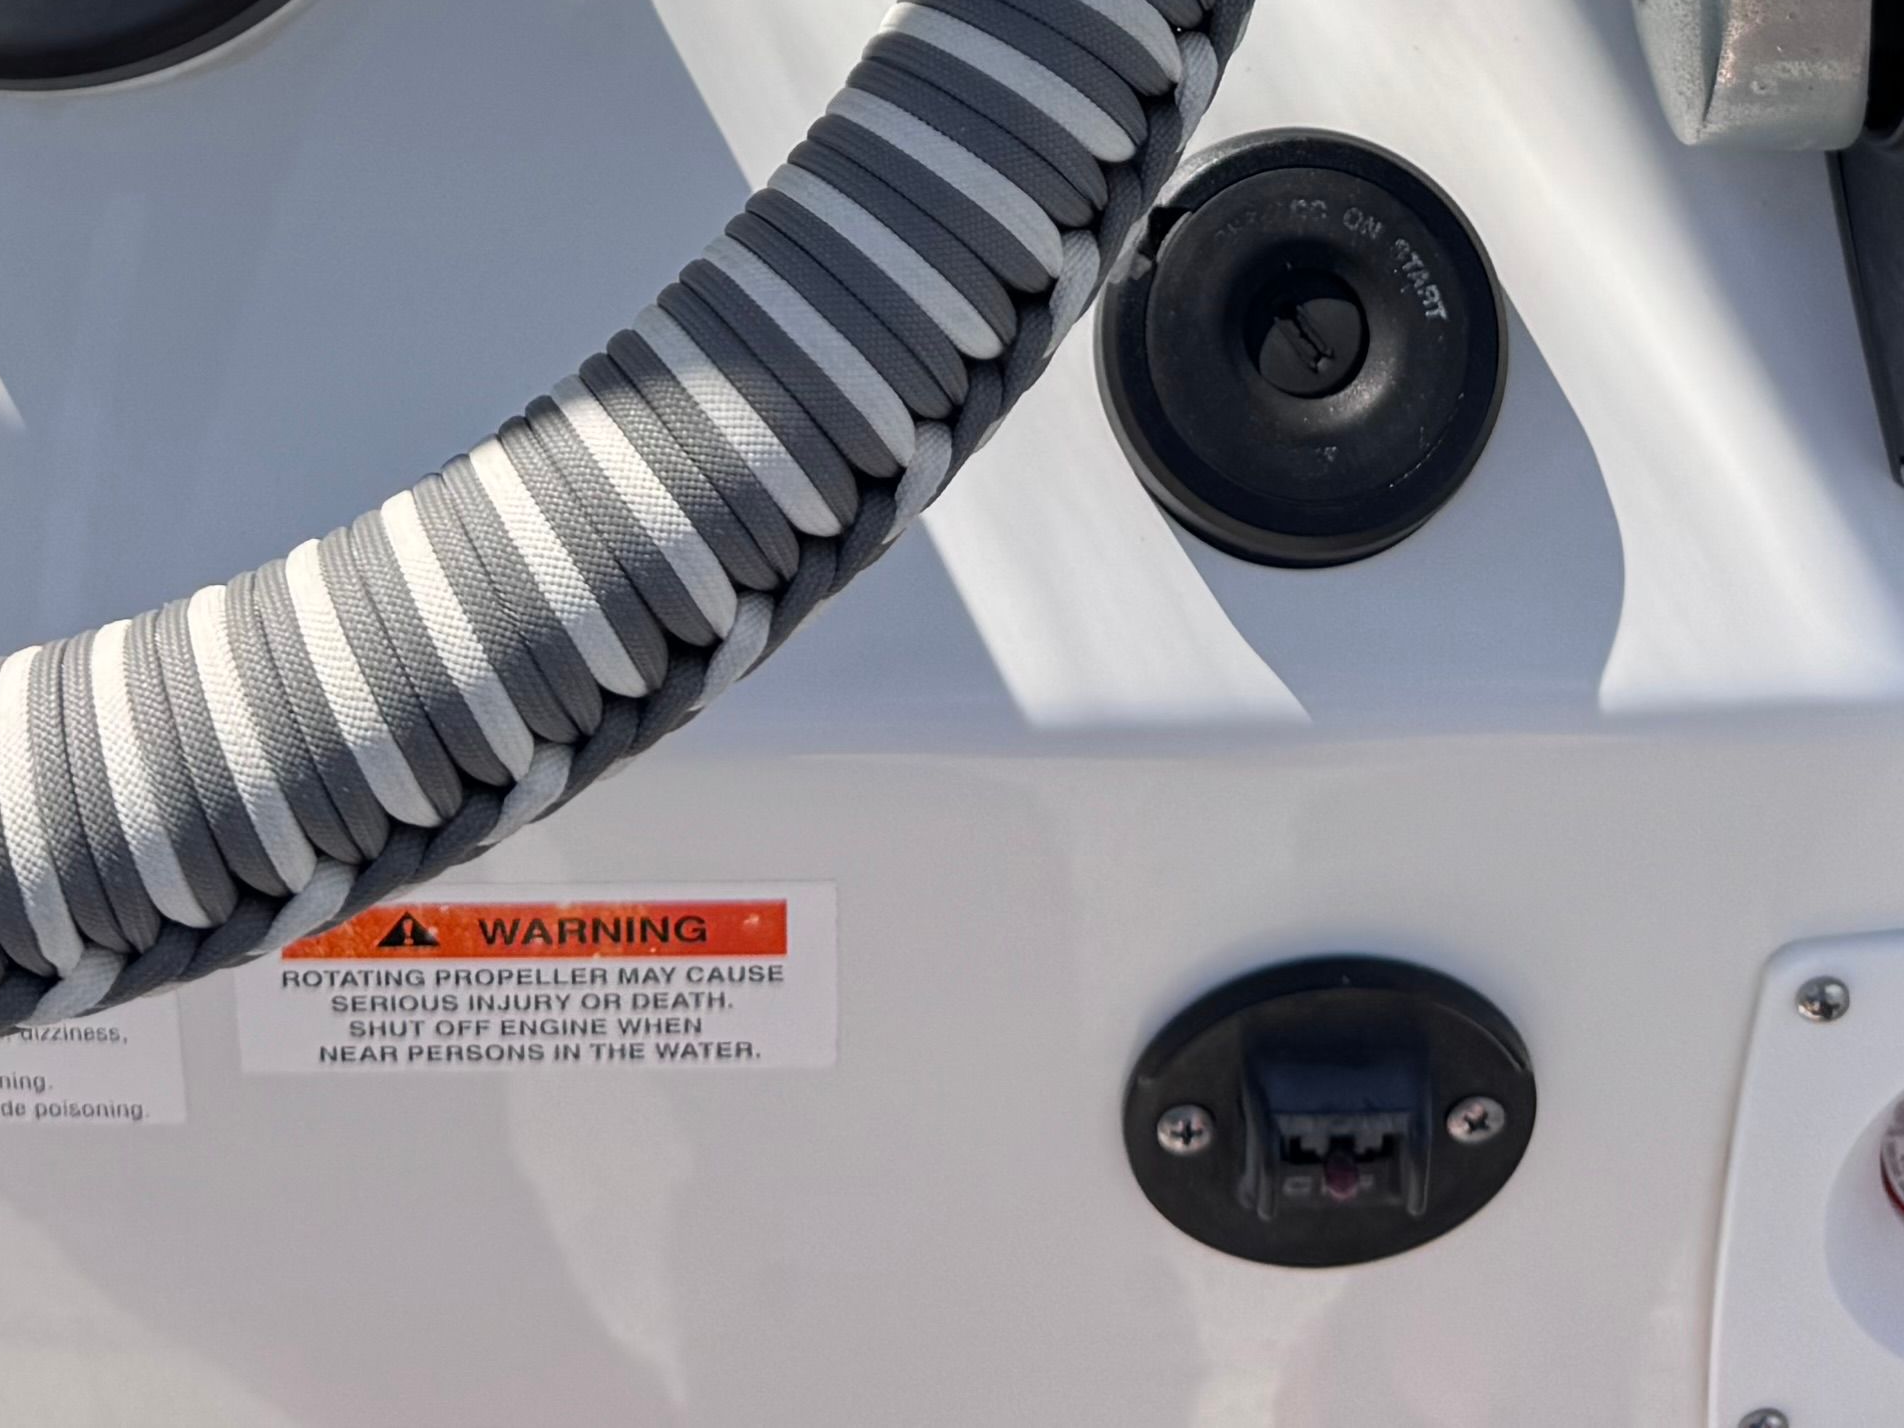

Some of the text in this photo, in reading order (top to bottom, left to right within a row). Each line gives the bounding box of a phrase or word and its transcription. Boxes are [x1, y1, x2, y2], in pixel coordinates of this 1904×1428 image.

[477, 914, 708, 946] WARNING
[281, 964, 786, 988] ROTATING PROPELLER MAY CAUSE
[331, 990, 735, 1013] SERIOUS INJURY OR DEATH.
[349, 1016, 704, 1039] SHUT OFF ENGINE WHEN
[318, 1040, 763, 1064] NEAR PERSONS IN THE WATER.
[33, 1098, 152, 1124] poisoning.
